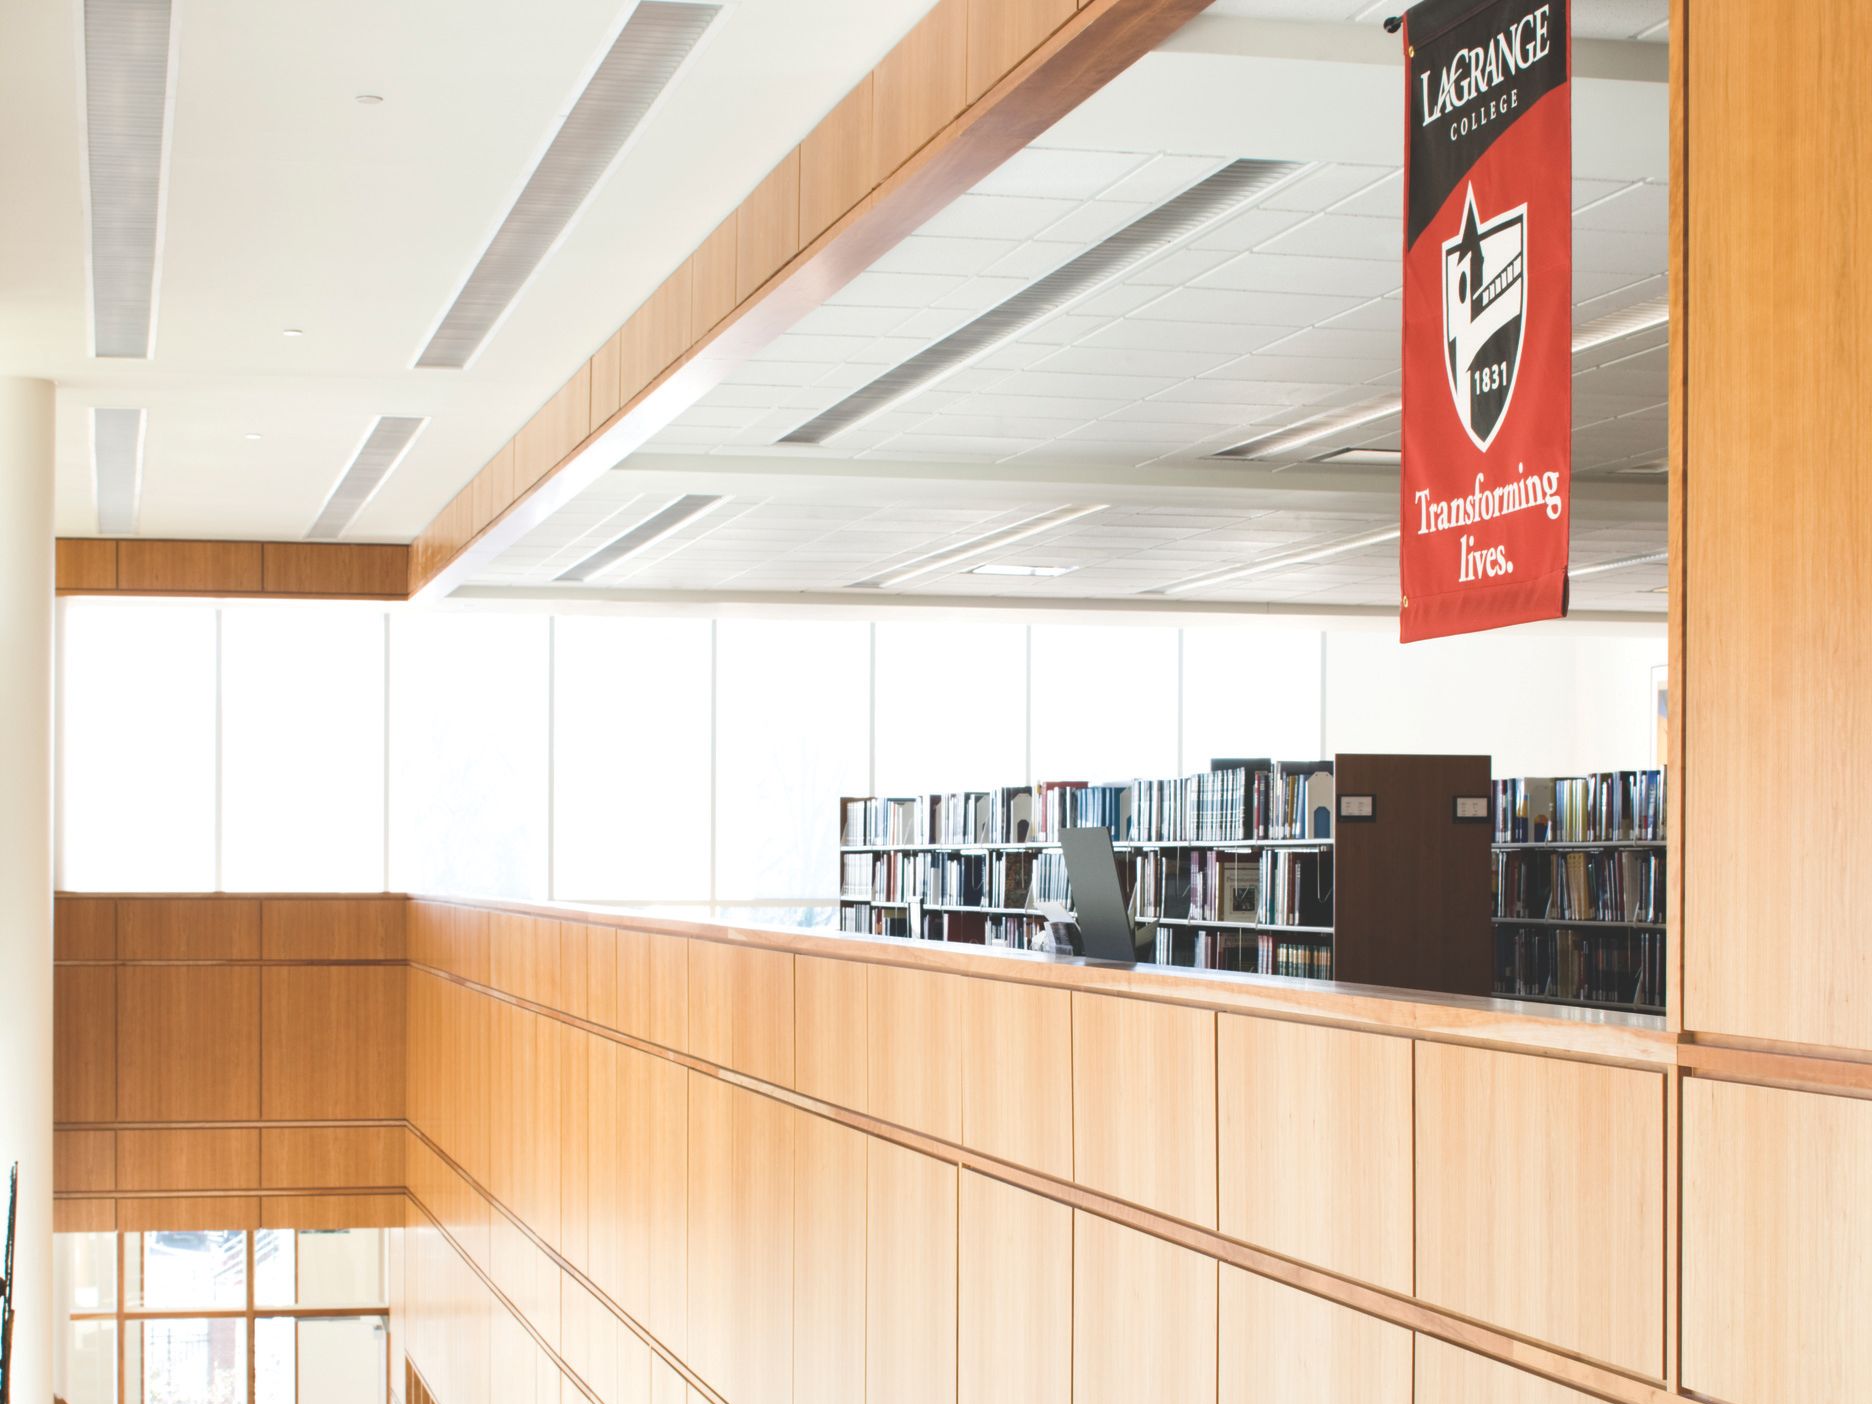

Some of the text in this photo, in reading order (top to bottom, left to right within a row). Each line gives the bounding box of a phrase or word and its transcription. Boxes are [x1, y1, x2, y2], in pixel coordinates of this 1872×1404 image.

[1420, 3, 1550, 127] LAGRANGE
[1450, 88, 1519, 141] COLLEGE
[1474, 360, 1508, 395] 1831
[1415, 462, 1562, 535] Transforming
[1458, 534, 1514, 583] lives.
